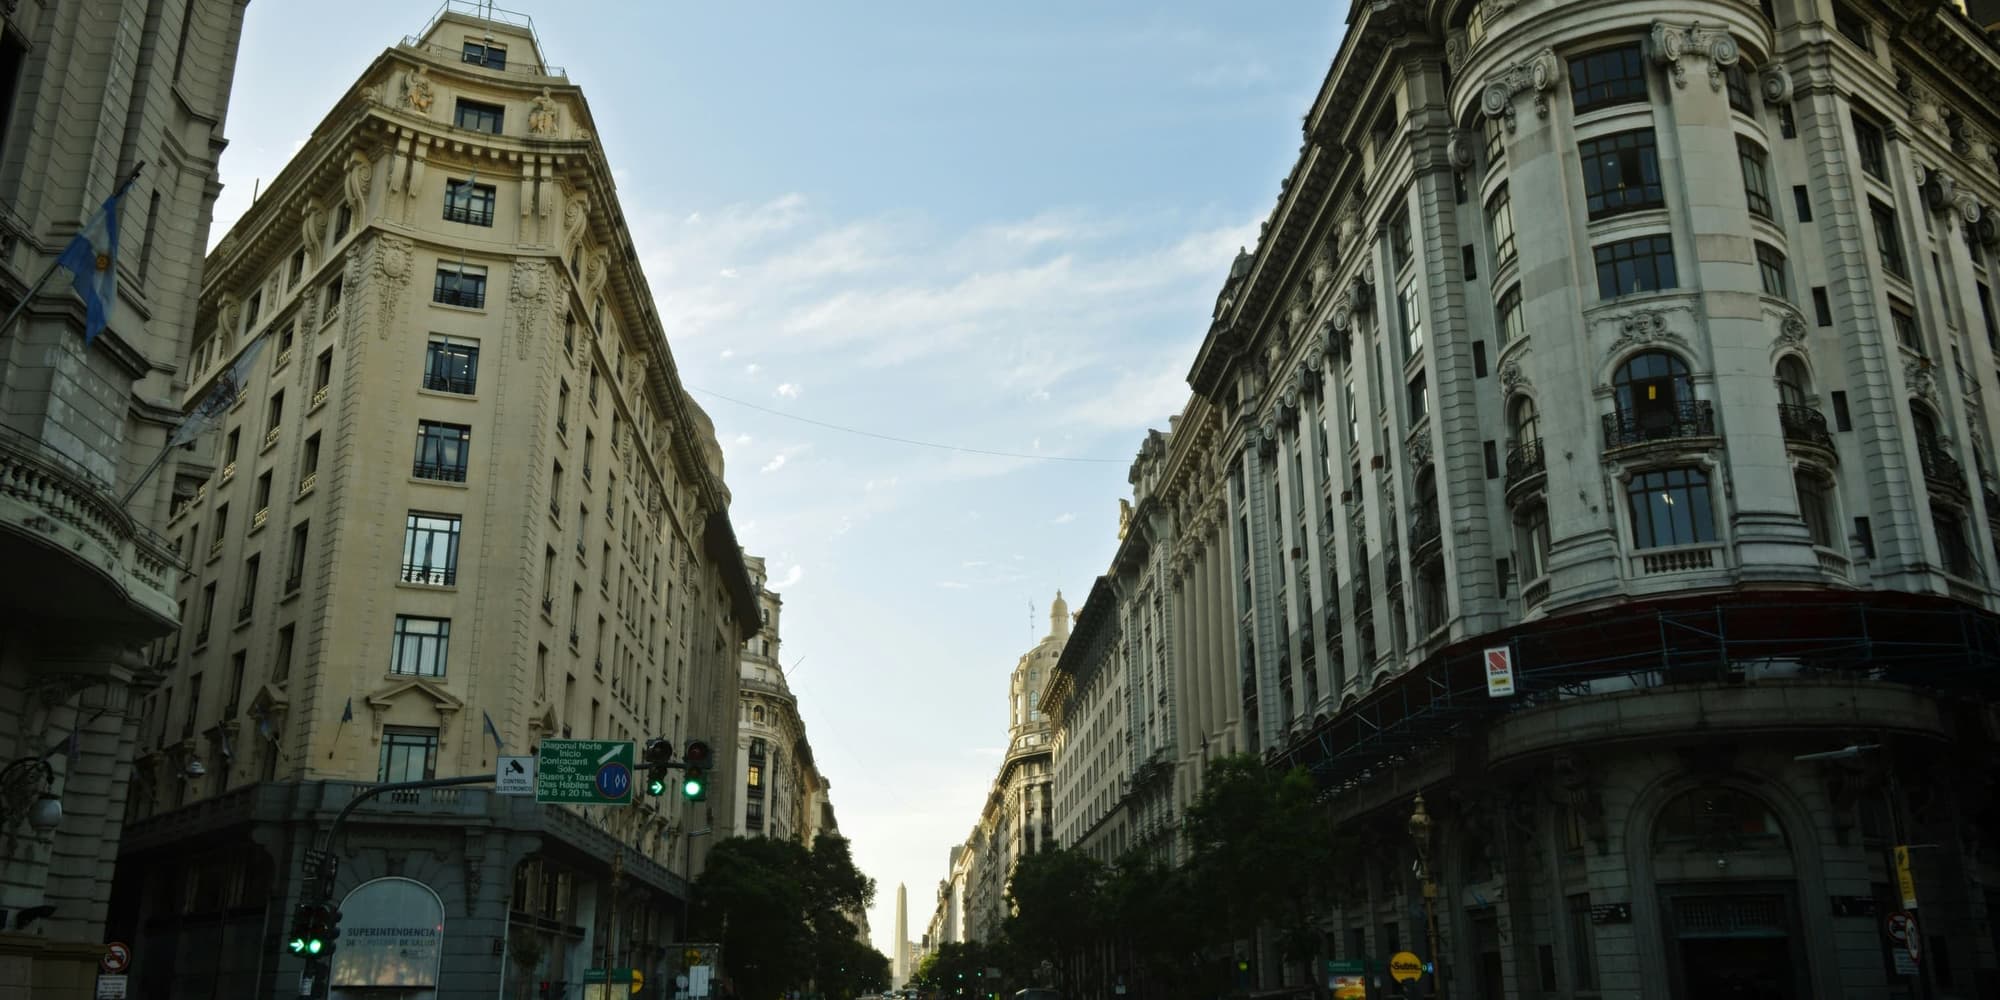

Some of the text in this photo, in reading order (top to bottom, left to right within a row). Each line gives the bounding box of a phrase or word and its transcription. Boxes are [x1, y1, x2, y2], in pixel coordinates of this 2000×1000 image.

[542, 741, 602, 751] Diagonal Norte
[557, 765, 576, 773] Solo
[539, 772, 565, 781] Buses
[538, 788, 549, 796] de
[551, 788, 558, 796] 8
[568, 789, 580, 797] 20
[347, 927, 435, 937] SUPERINTENDENCIA
